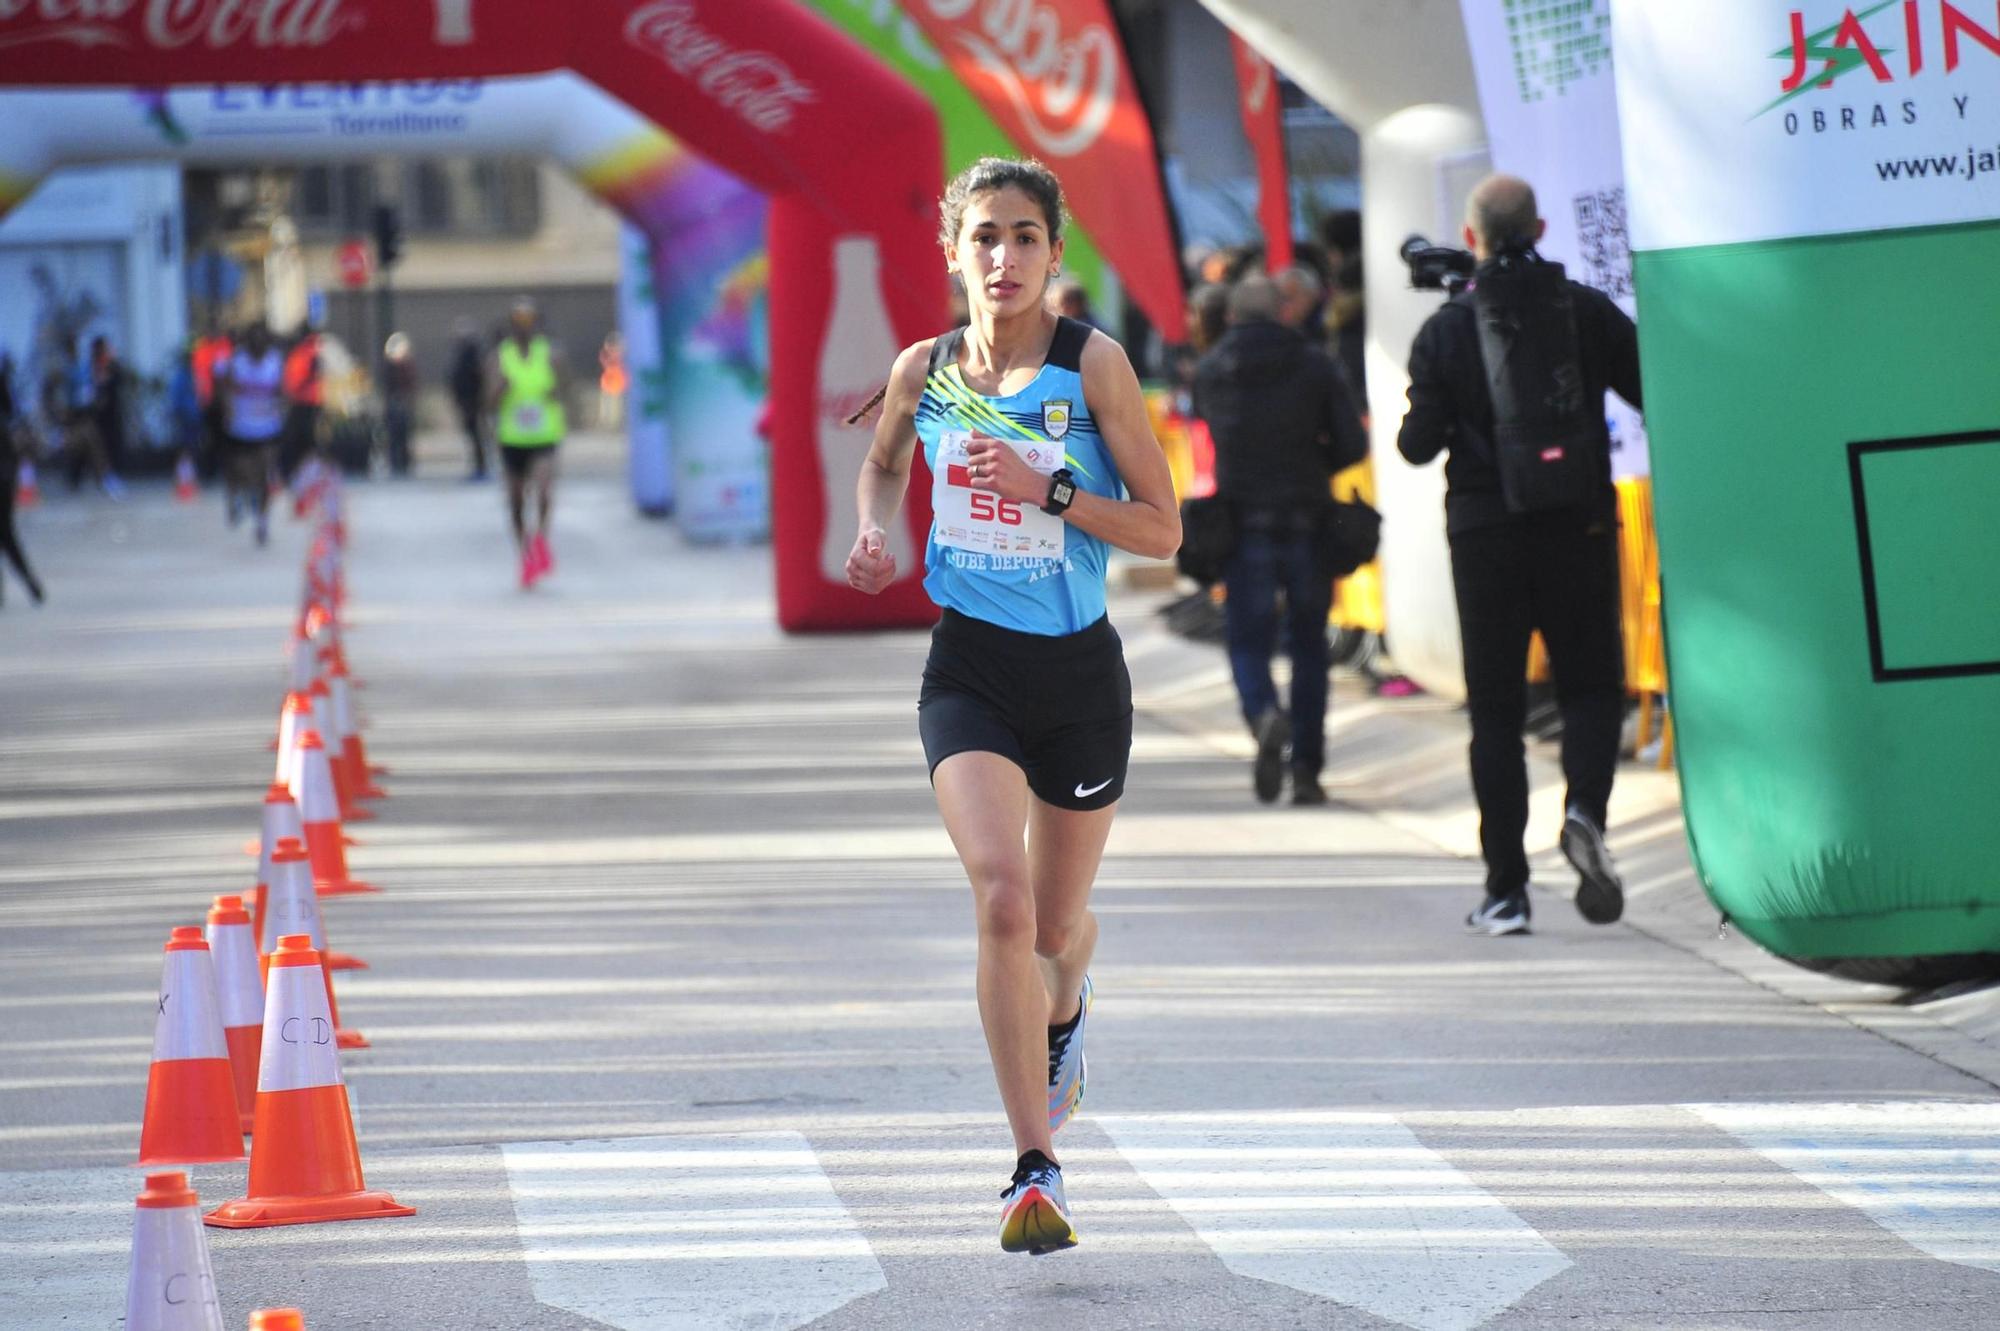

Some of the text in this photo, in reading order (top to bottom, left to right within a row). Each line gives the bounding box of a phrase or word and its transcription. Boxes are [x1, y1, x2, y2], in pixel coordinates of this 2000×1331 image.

[1784, 95, 1969, 136] OBRAS Y
[970, 493, 1022, 526] 56
